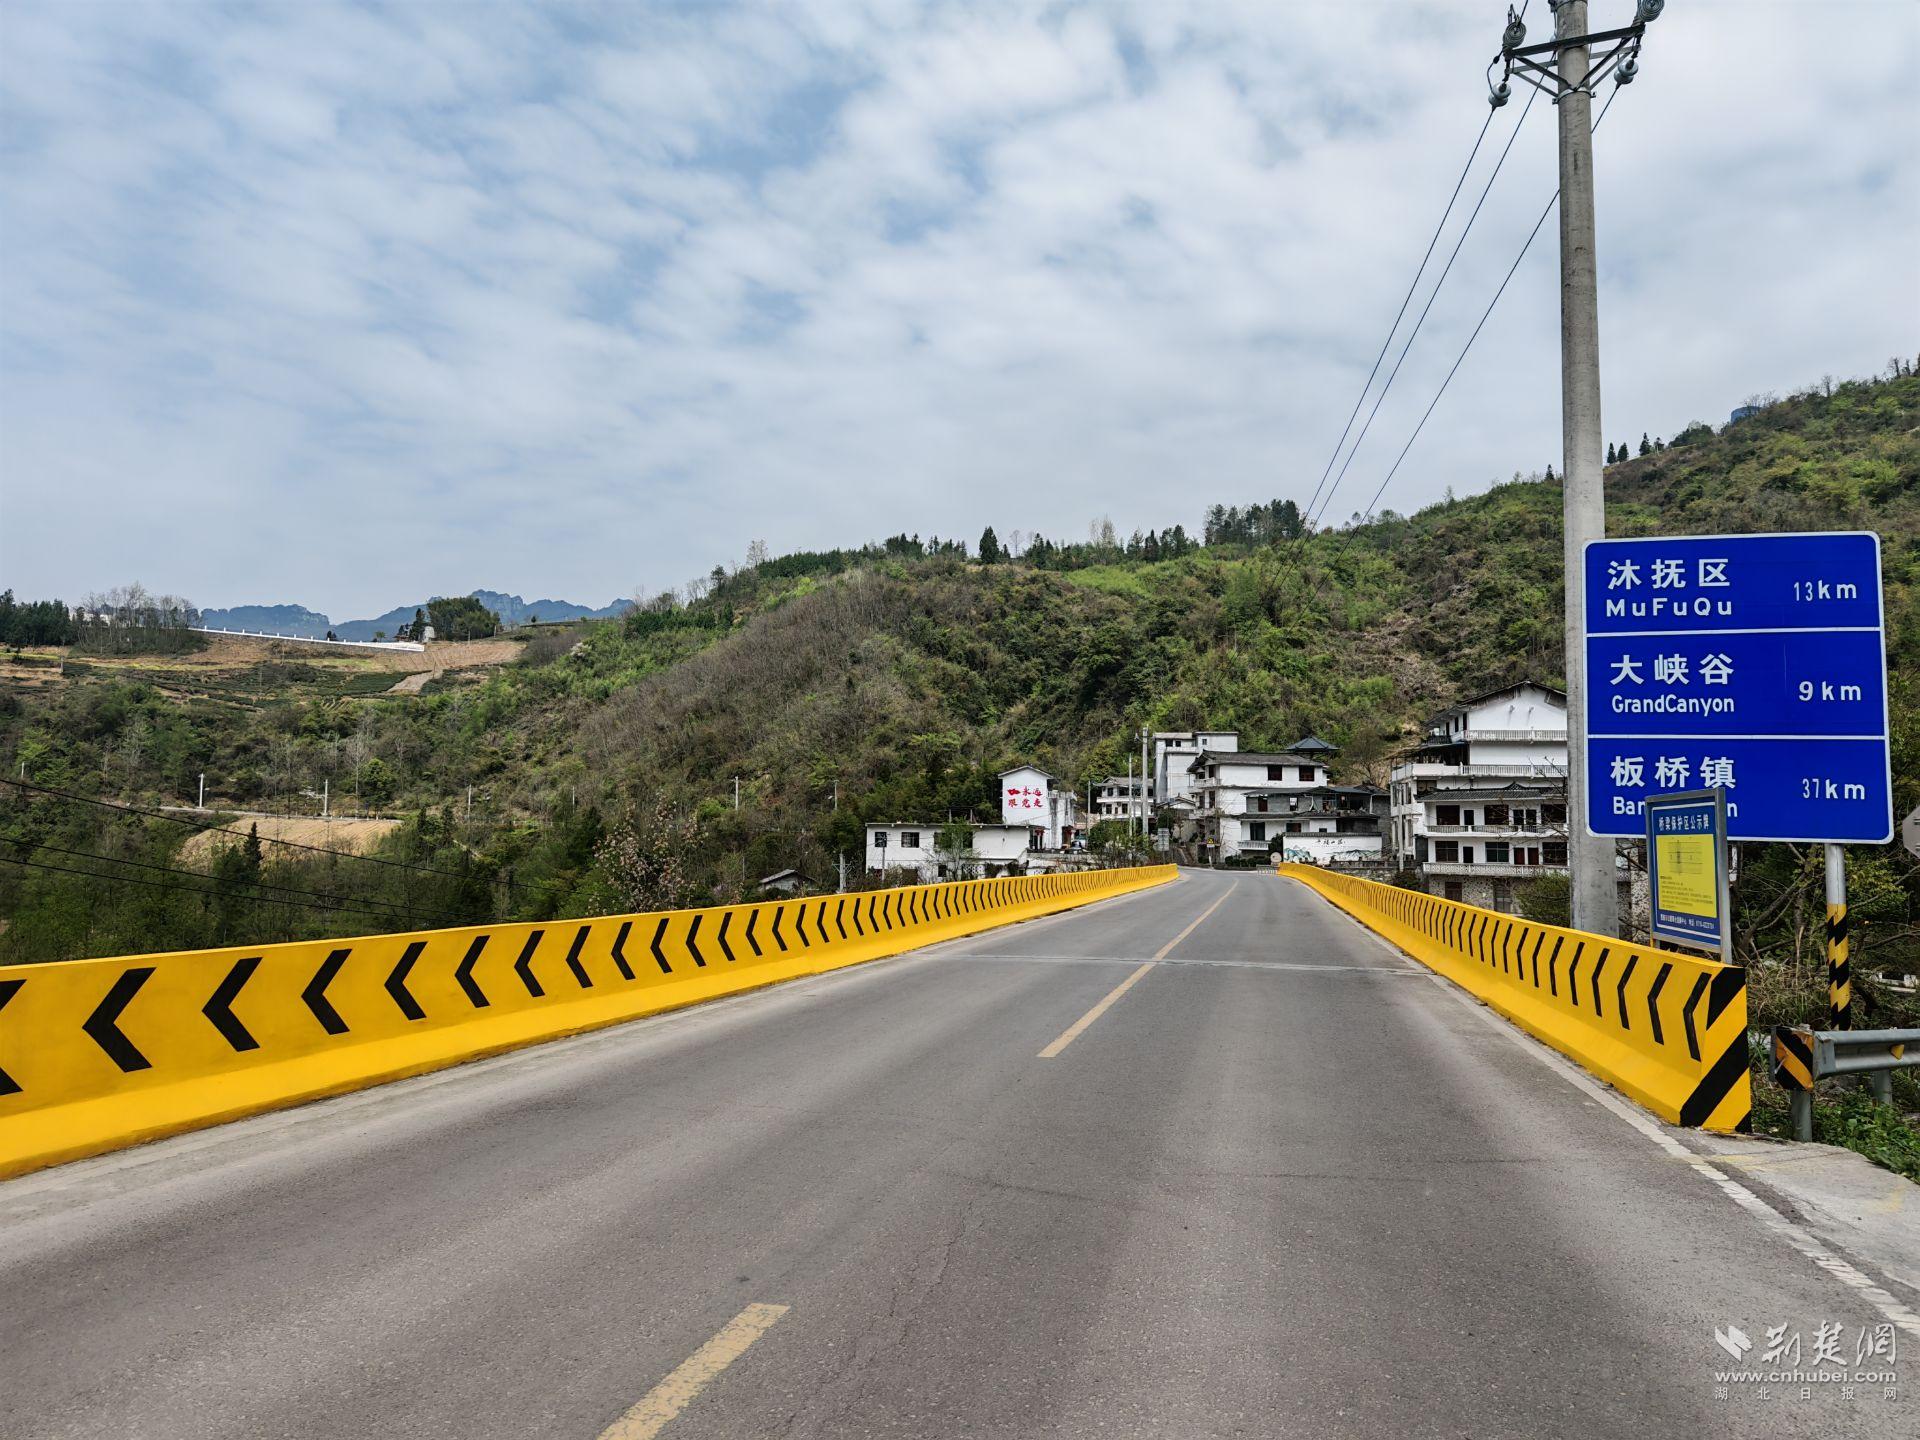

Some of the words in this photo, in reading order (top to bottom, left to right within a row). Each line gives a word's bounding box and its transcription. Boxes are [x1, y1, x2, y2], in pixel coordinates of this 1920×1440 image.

[1607, 558, 1730, 589] 沐抚区
[1606, 597, 1732, 617] MuFuQu
[1609, 653, 1734, 685] 大峡谷
[1611, 693, 1735, 717] GrandCanyon
[1610, 755, 1736, 789] 板桥镇
